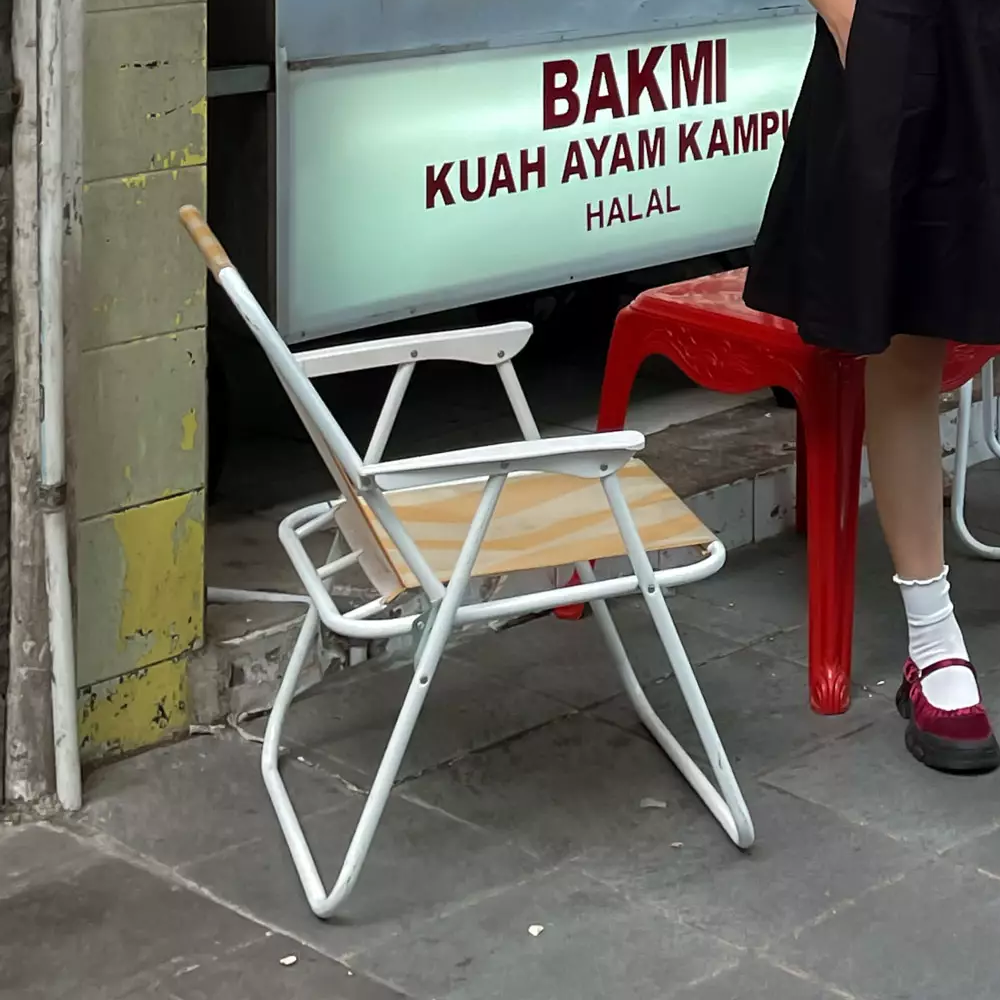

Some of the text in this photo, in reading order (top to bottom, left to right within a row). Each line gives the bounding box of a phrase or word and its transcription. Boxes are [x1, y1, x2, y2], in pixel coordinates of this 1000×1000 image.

[542, 38, 728, 131] BAKMI
[425, 145, 547, 210] KUAH
[561, 126, 666, 184] AYAM
[586, 185, 680, 232] HALAL
